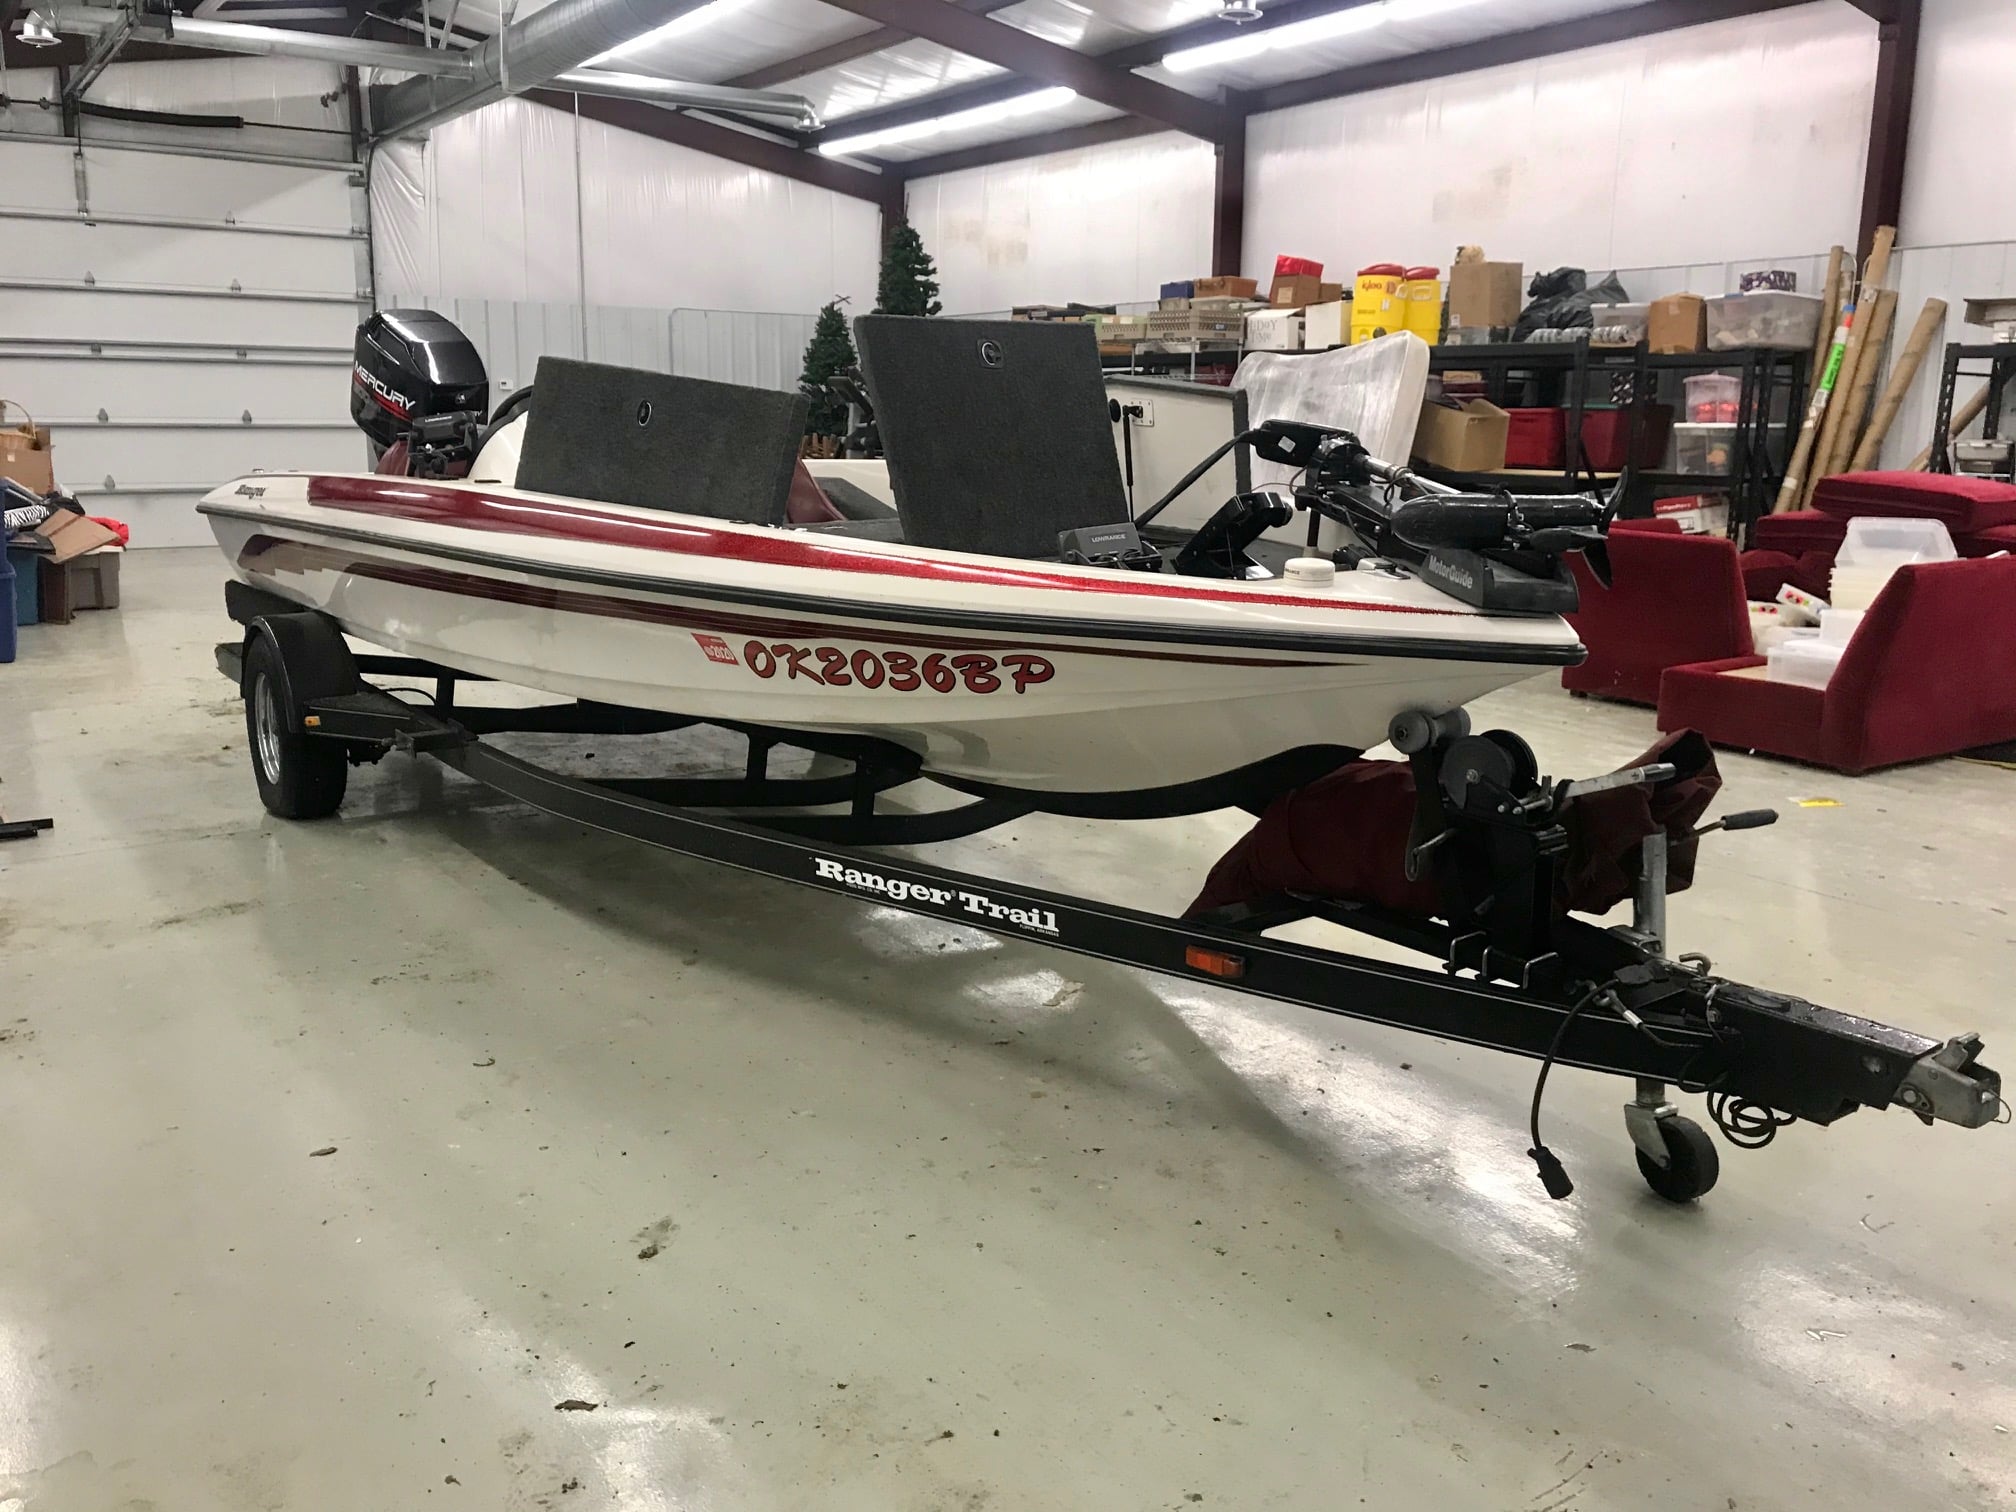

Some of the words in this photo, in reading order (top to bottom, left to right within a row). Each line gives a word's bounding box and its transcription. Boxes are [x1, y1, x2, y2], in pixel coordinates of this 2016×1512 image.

[354, 360, 416, 411] MERCURY
[1091, 533, 1126, 543] LOWRANCE
[1428, 554, 1473, 589] MotorGuide
[743, 640, 1055, 694] OK2036BP
[815, 857, 952, 905] Ranger
[958, 891, 1060, 932] Trail
